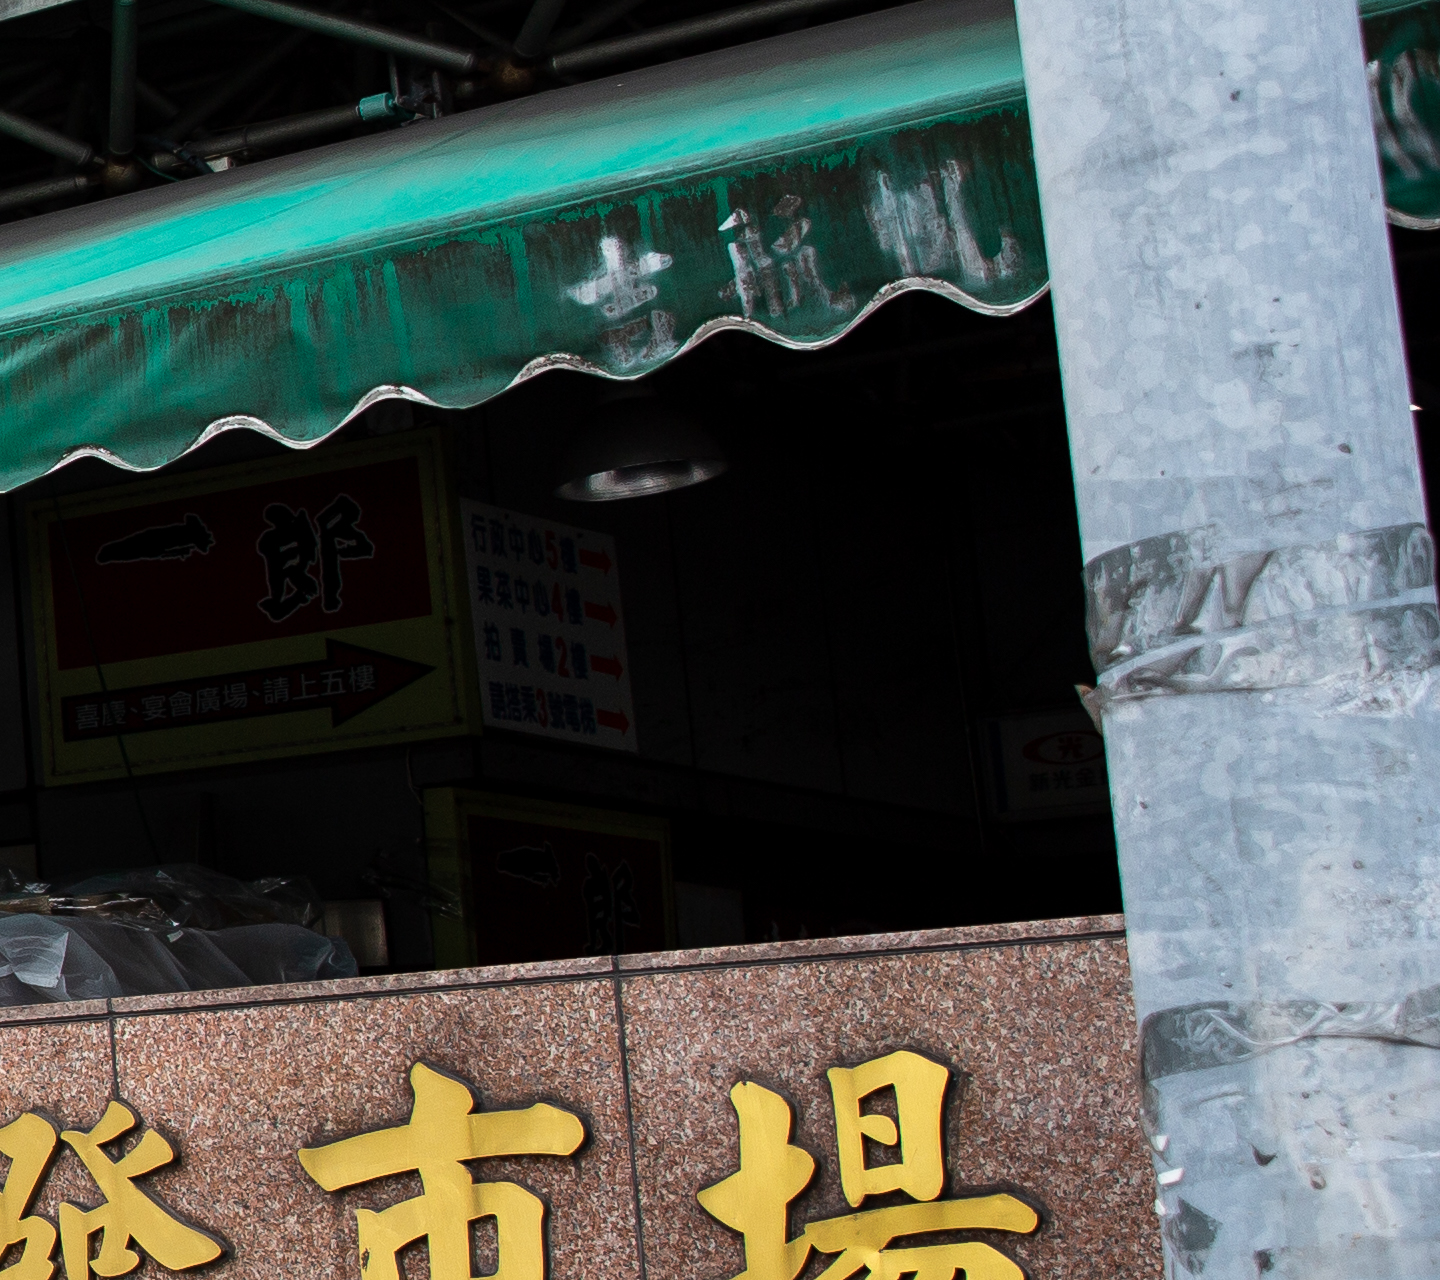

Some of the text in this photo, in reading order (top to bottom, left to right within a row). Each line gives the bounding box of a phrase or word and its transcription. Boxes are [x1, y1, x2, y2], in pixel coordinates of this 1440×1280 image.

[95, 492, 376, 624] 一郎
[1029, 766, 1110, 792] 新光金
